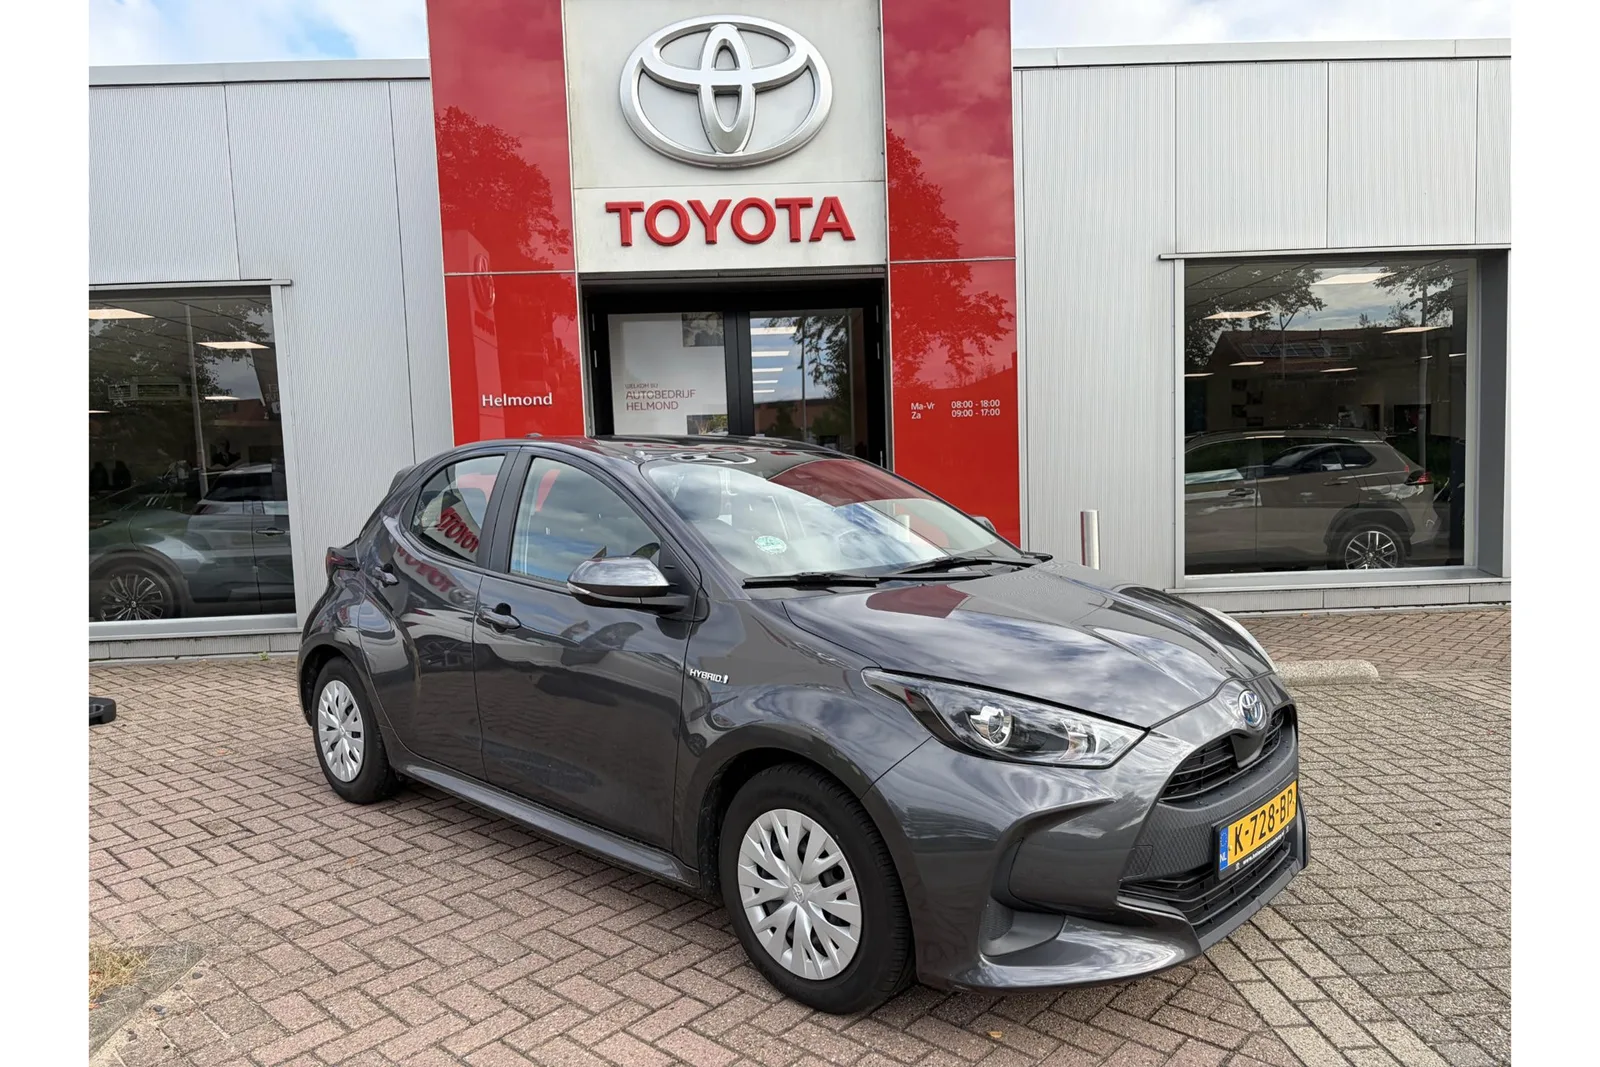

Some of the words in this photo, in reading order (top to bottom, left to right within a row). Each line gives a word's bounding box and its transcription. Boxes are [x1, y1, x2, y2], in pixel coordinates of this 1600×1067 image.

[605, 196, 856, 246] TOYOTA
[482, 392, 552, 407] Helmond
[626, 389, 696, 400] AUTOBEDRIJF
[626, 401, 679, 411] HELMOND
[911, 402, 935, 410] Ma-Vr
[951, 400, 973, 409] 08:00
[980, 399, 1000, 407] 18:00
[911, 411, 921, 419] Za
[951, 409, 973, 418] 09:00
[980, 408, 1000, 416] 17:00
[1234, 788, 1293, 856] K-728-BP
[1220, 851, 1227, 863] NL
